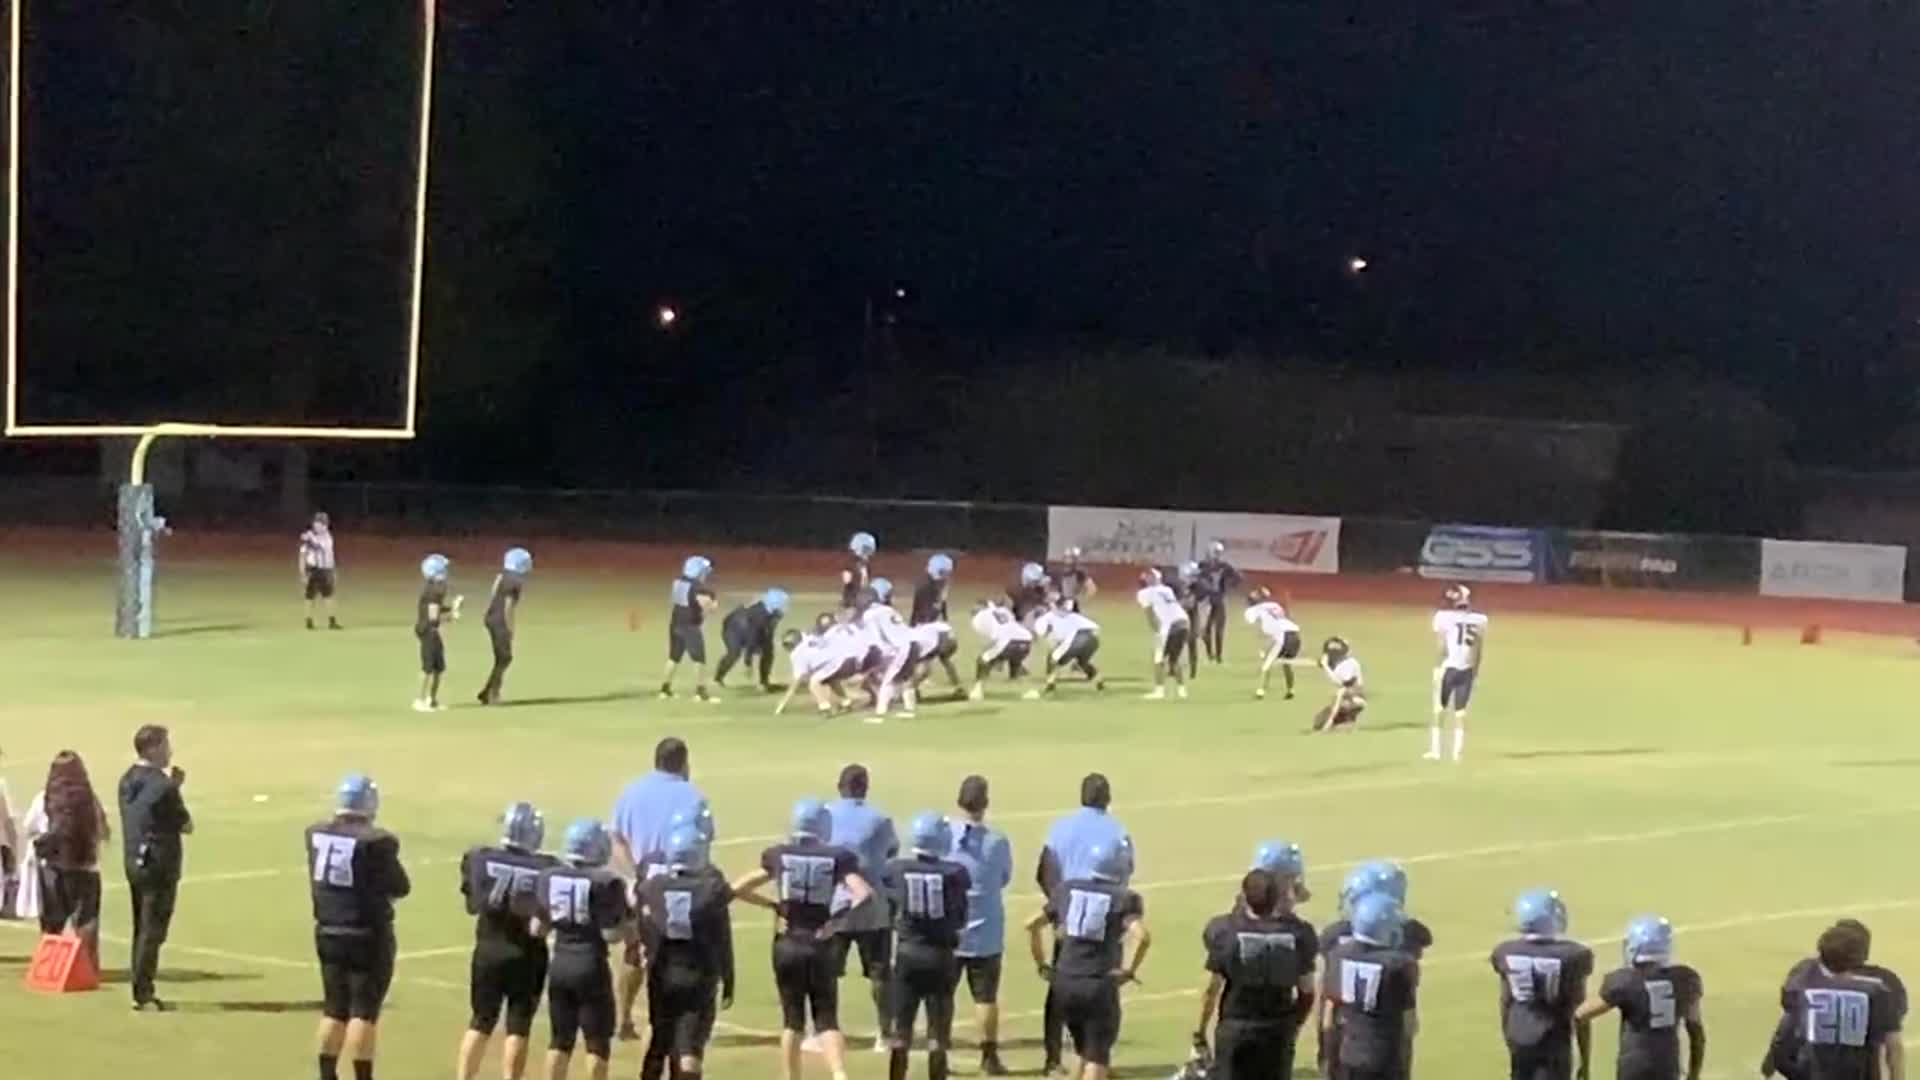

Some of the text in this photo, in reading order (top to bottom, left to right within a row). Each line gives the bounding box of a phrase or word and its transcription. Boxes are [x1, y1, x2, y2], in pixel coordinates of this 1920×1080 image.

[1455, 622, 1478, 647] 15
[312, 832, 356, 887] 73
[1341, 960, 1383, 1011] 17
[1645, 980, 1676, 1028] 5
[1804, 988, 1868, 1046] 20
